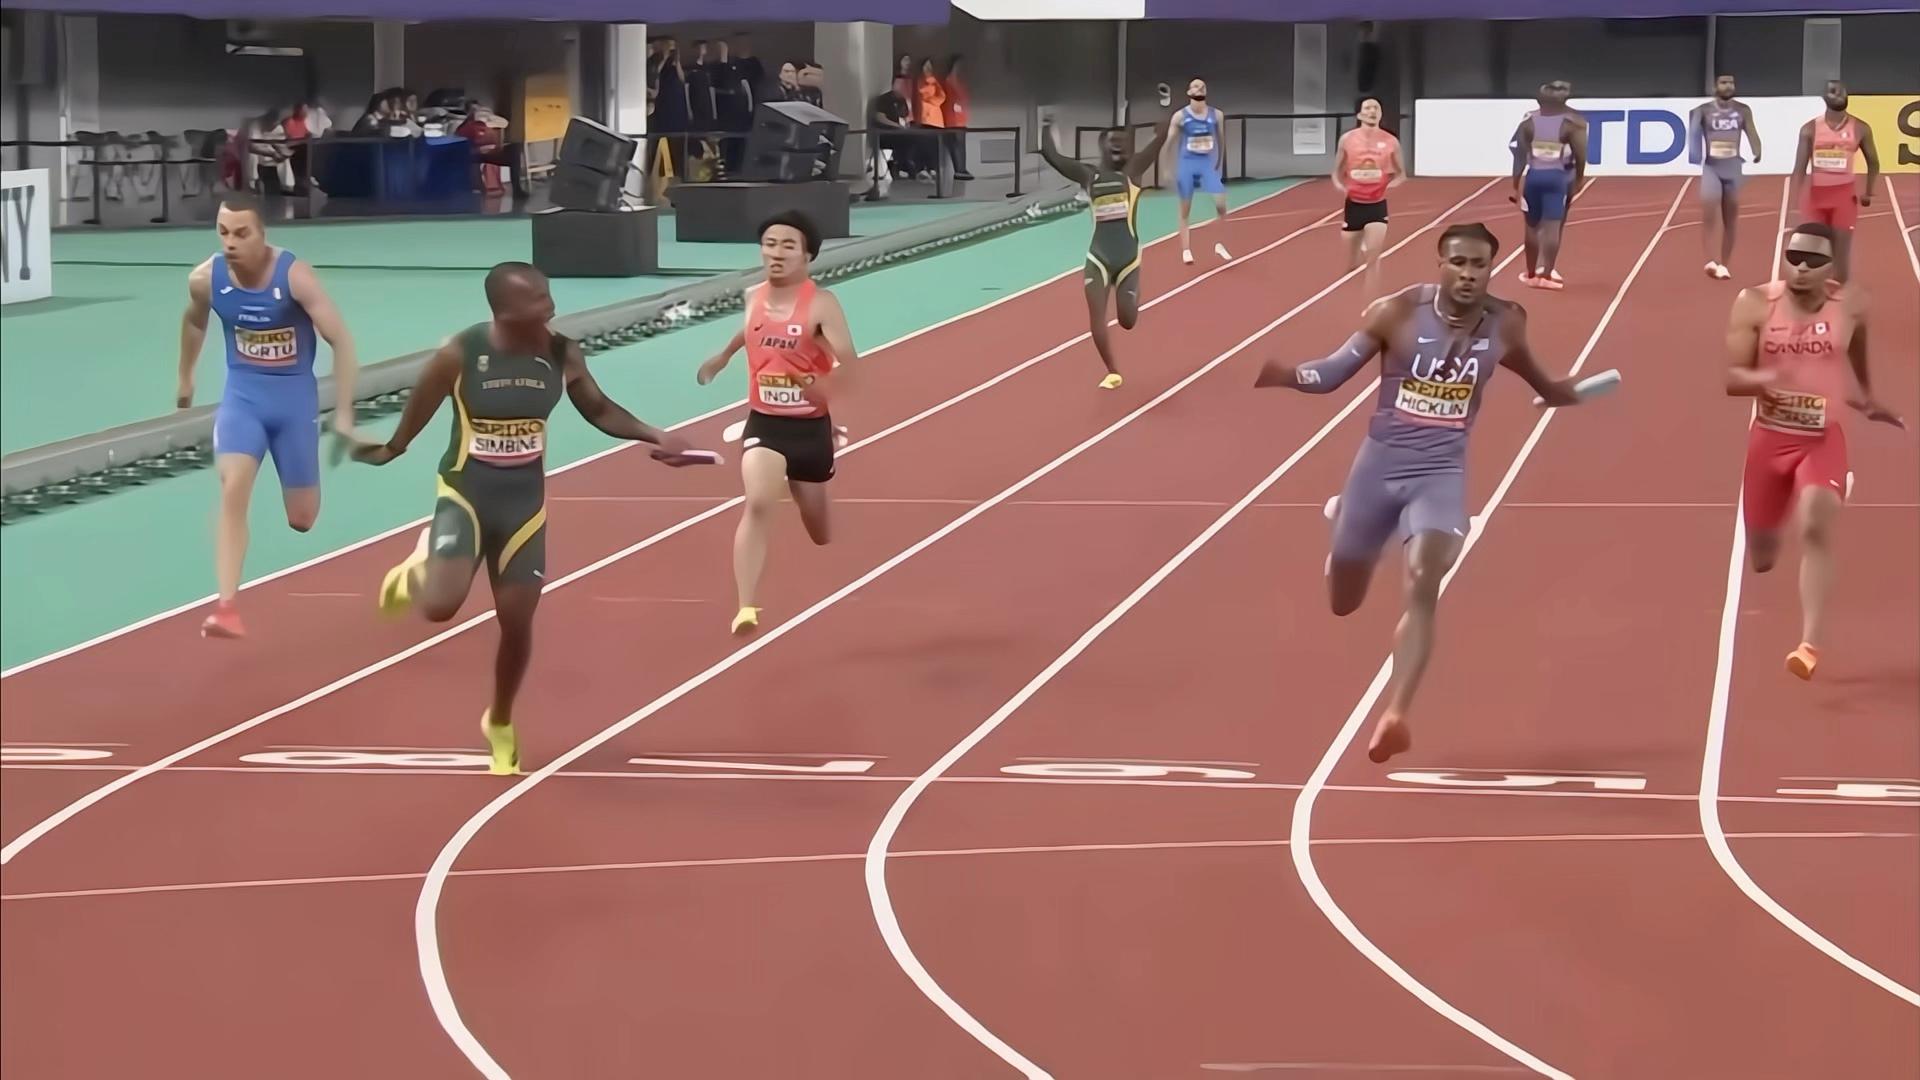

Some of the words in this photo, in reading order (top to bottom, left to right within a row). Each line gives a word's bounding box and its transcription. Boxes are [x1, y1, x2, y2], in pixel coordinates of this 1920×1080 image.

[1712, 118, 1739, 130] USA
[1574, 109, 1702, 165] TD
[242, 343, 293, 358] TORTU
[760, 337, 798, 349] JAPAN
[1764, 340, 1833, 355] CANADA
[1411, 353, 1479, 385] USA
[1402, 380, 1471, 401] SEIKO
[1400, 394, 1465, 416] HICKLIN
[472, 421, 544, 437] SEIKO
[475, 436, 538, 453] SIMBINE
